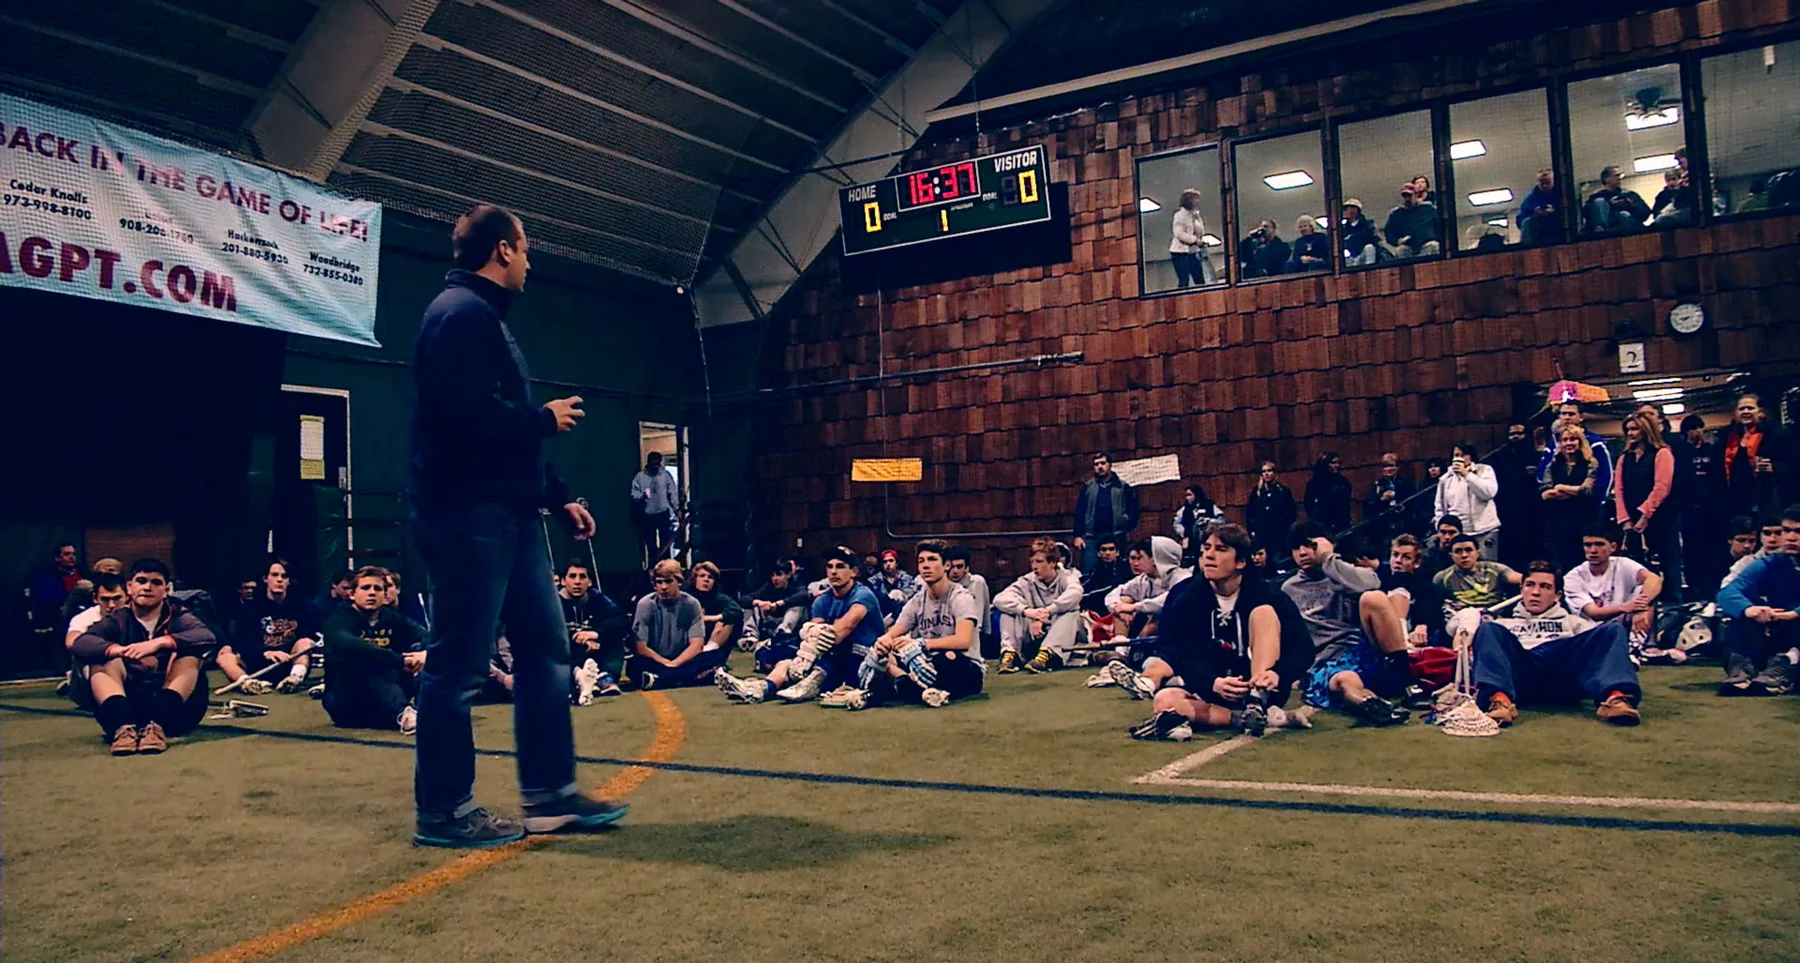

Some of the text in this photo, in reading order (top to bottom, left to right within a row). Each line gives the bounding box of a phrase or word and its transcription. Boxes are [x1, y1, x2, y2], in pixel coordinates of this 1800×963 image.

[994, 151, 1037, 173] VISITOR
[10, 179, 88, 204] Cedar Knolls
[848, 185, 877, 202] HOME
[909, 163, 976, 205] 16:37
[134, 158, 186, 192] THE
[196, 175, 271, 215] GAME
[279, 200, 311, 225] OF
[320, 211, 368, 242] LIFE!
[309, 251, 360, 273] Woodbridge
[1626, 351, 1640, 368] 2
